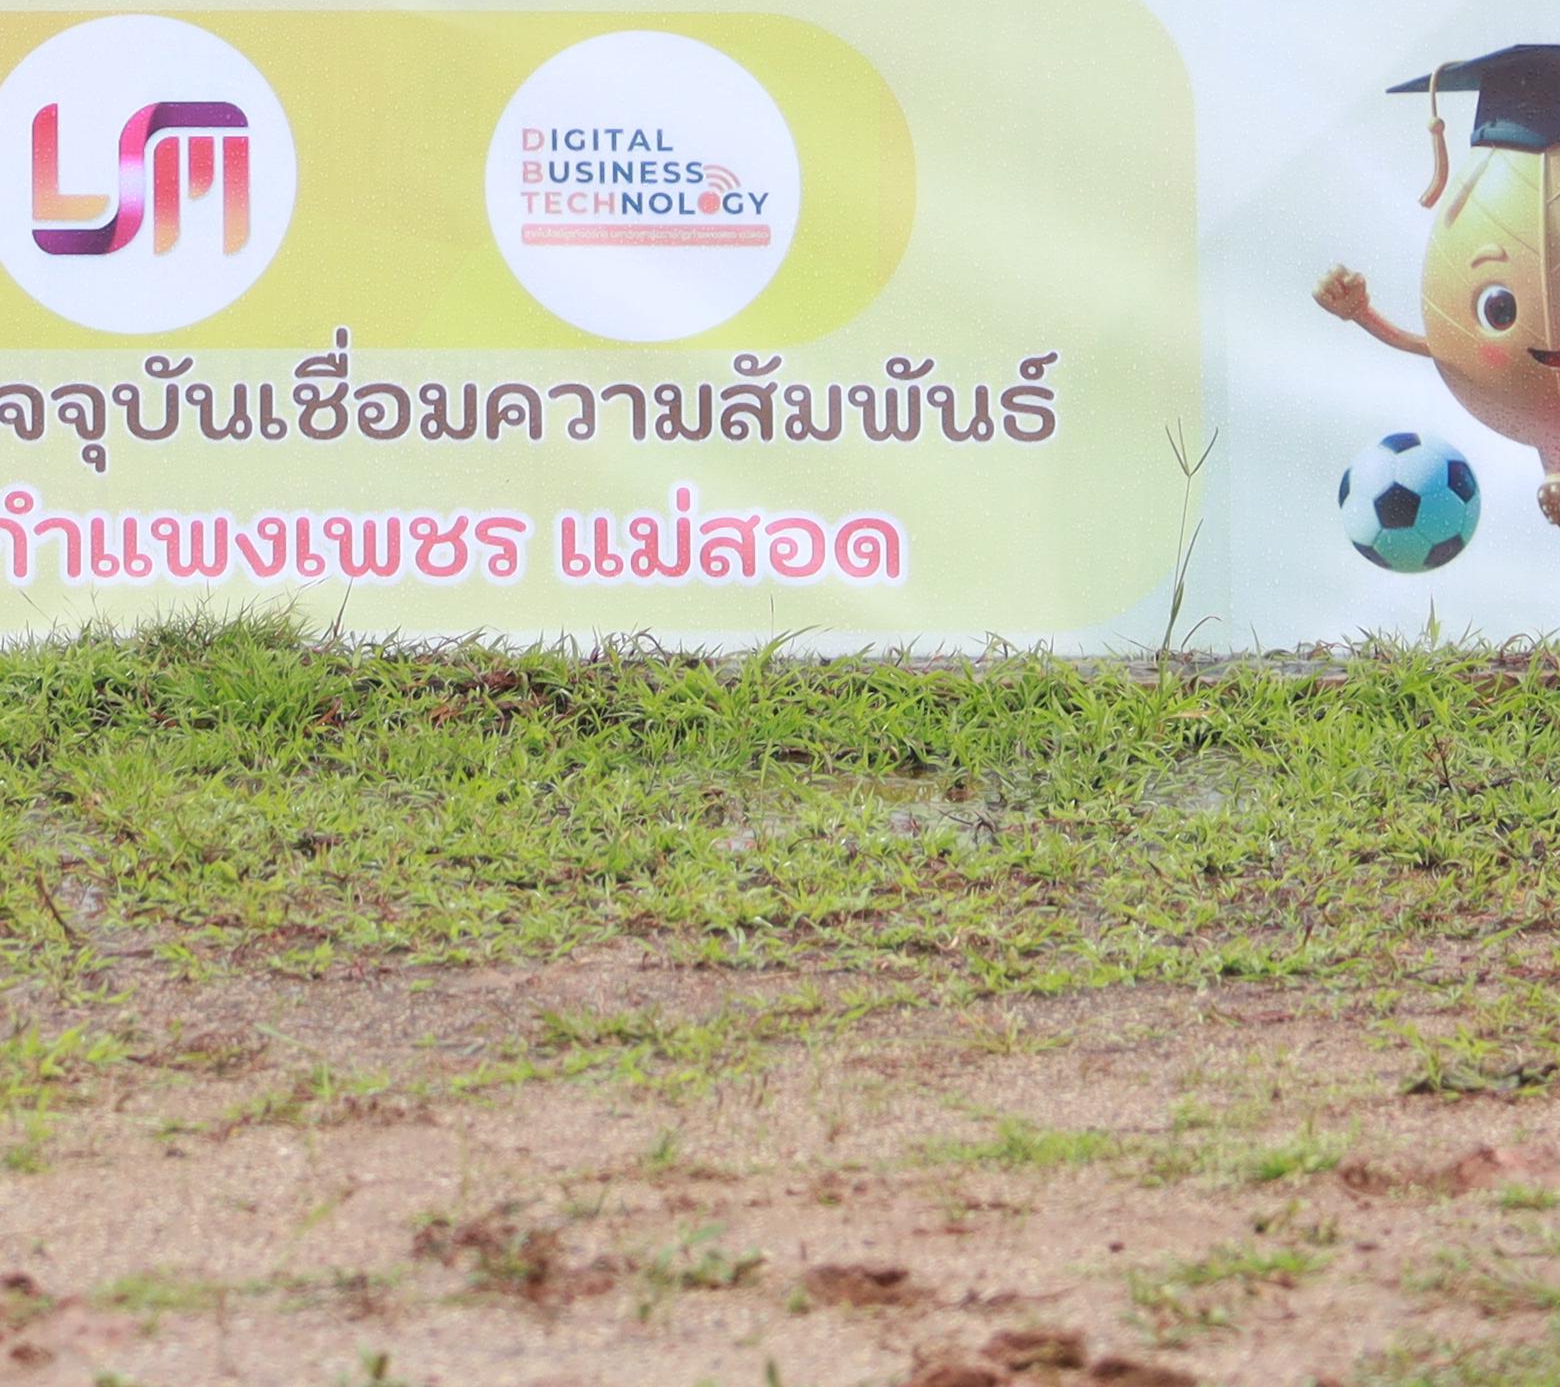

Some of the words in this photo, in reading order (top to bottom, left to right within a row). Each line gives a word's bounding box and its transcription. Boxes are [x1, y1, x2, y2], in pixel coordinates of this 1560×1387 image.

[522, 128, 674, 152] DIGITAL
[522, 161, 705, 185] BUSINESS
[520, 191, 769, 216] TECHNOLOGY
[560, 487, 901, 580] แม่สอด
